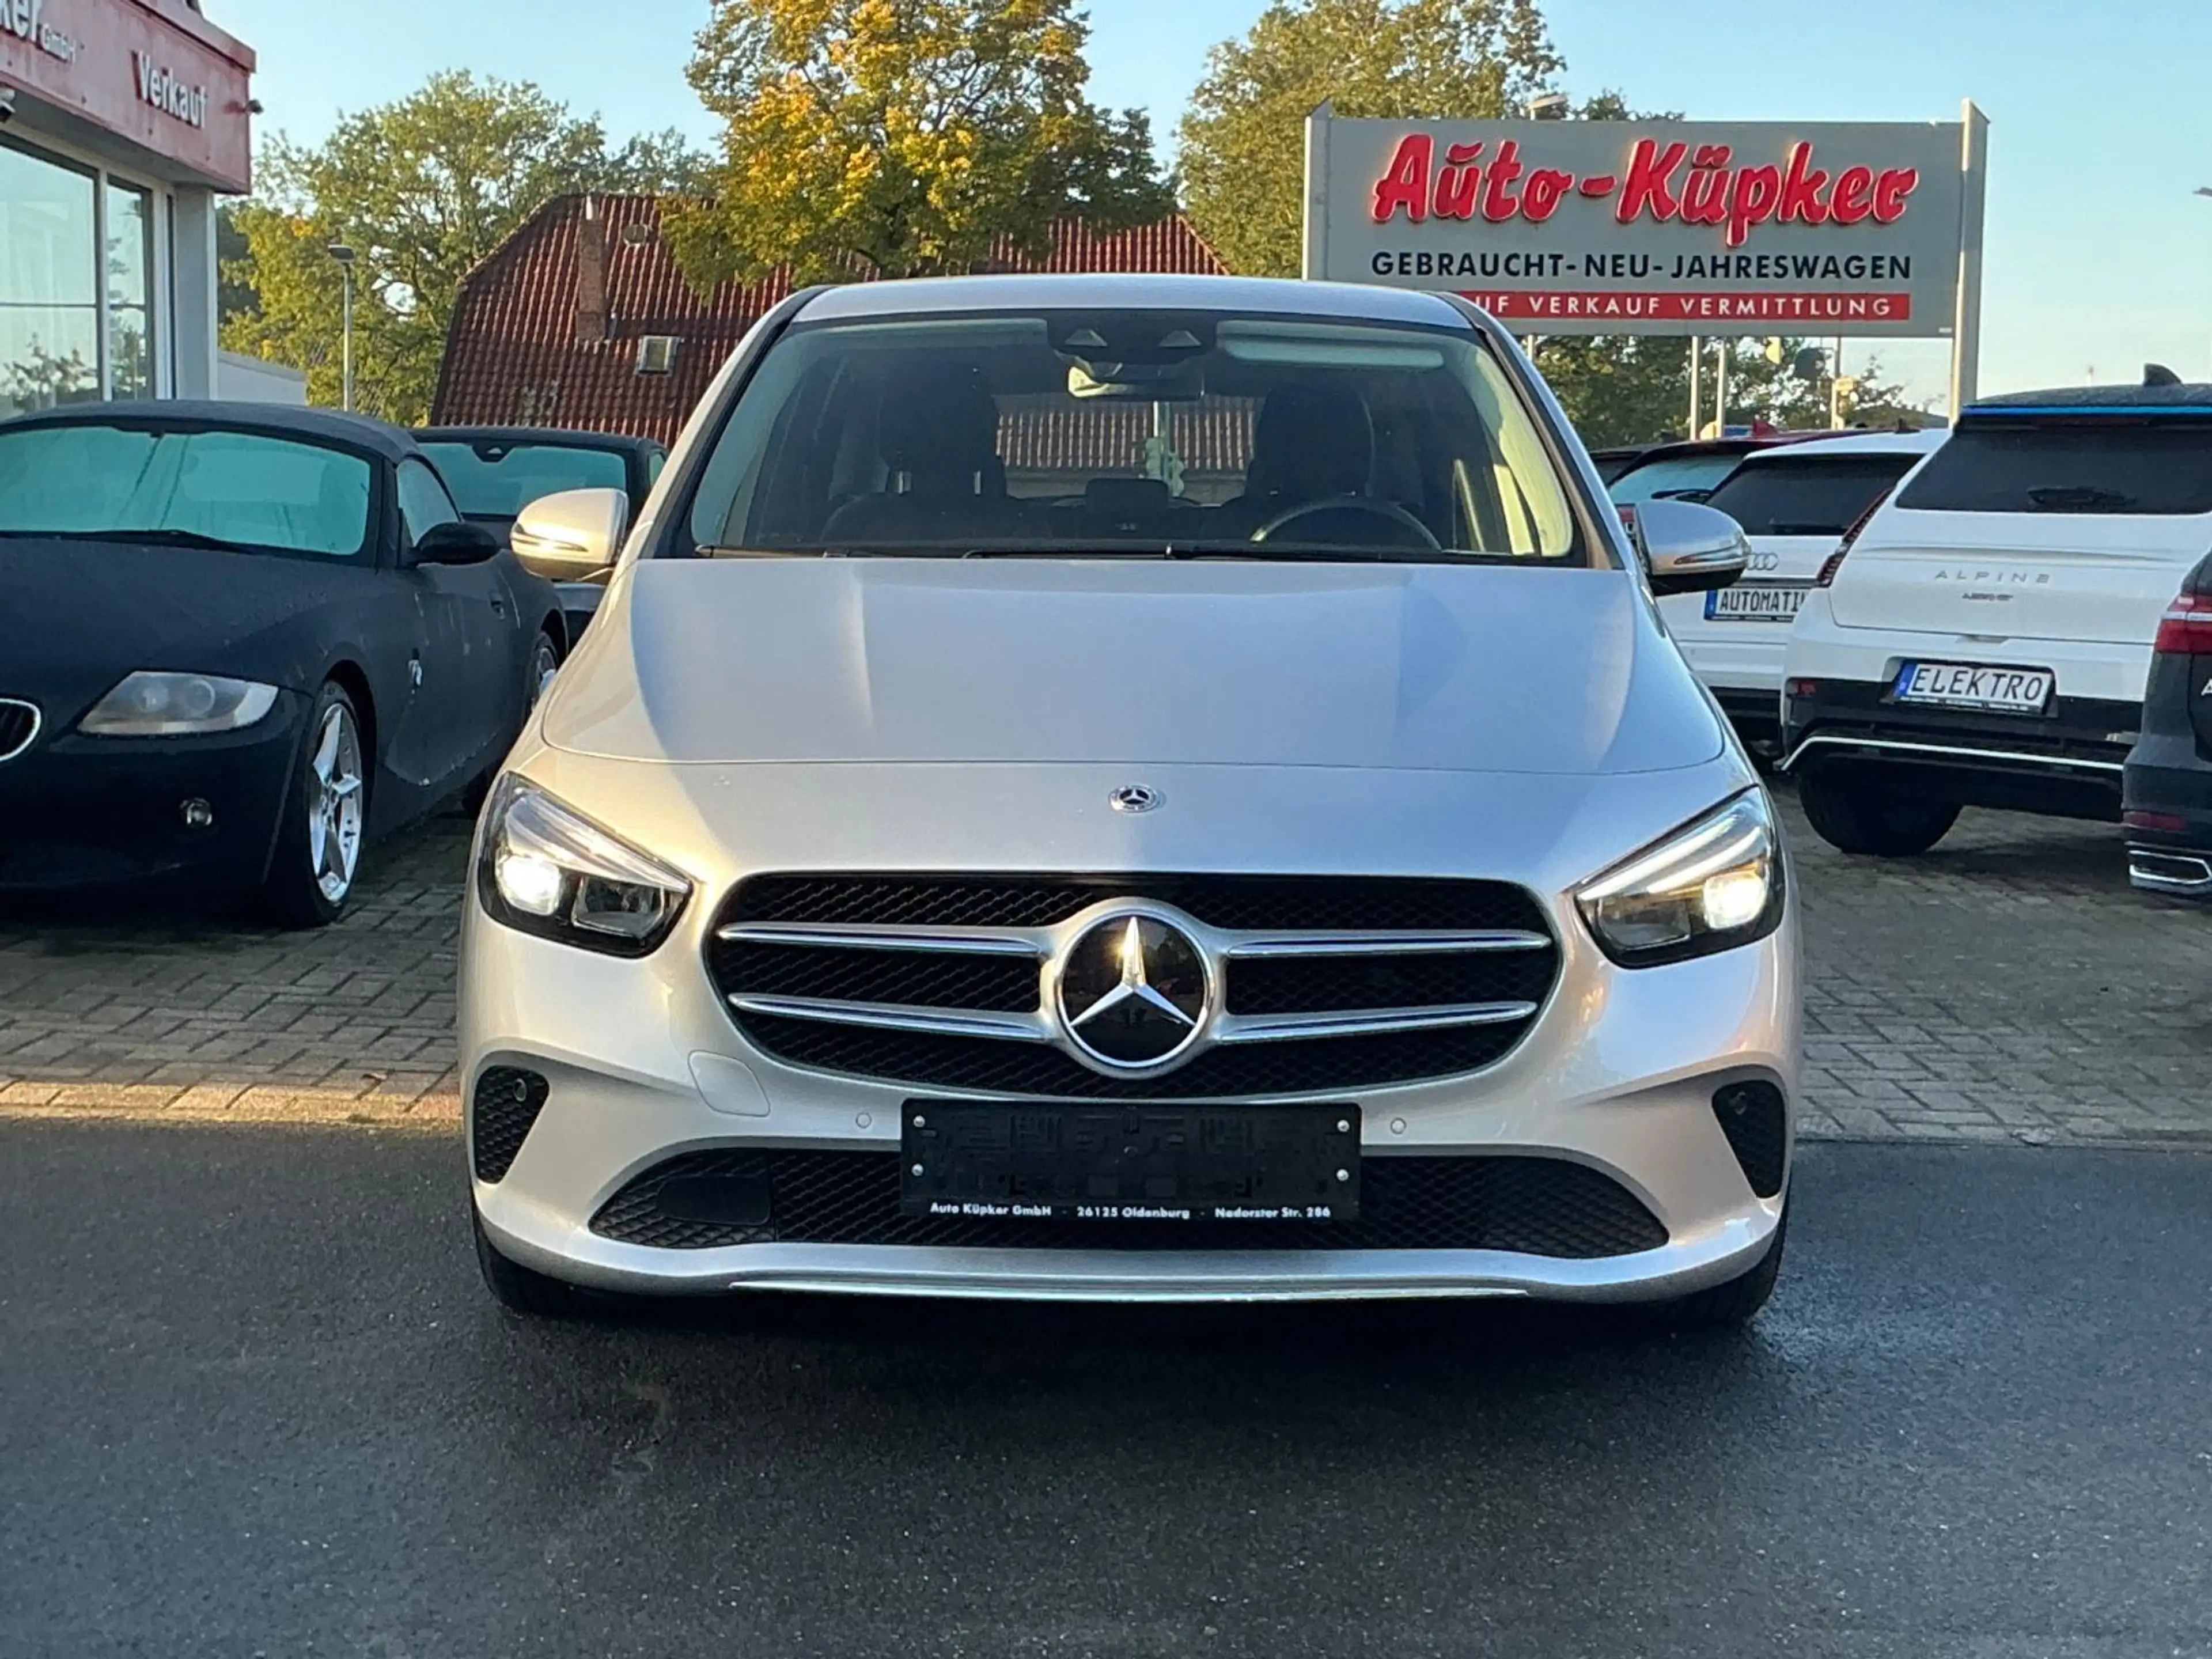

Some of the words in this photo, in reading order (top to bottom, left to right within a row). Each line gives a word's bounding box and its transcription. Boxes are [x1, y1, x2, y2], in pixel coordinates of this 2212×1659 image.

[138, 50, 207, 130] Verkauf
[1475, 296, 1510, 314] UF
[1528, 296, 1660, 315] VERKAUF
[1680, 298, 1892, 316] VERMITTLUNG
[1935, 570, 2050, 584] ALPINE
[1910, 668, 2043, 700] ELEKTRO
[930, 1202, 959, 1214] Auto
[963, 1203, 1009, 1217] Küpker
[1012, 1205, 1051, 1216] GmbH
[1077, 1206, 1118, 1217] 26125
[1121, 1206, 1190, 1220] Oldenburg
[1281, 1207, 1303, 1218] Str.
[1306, 1206, 1331, 1218] 286
